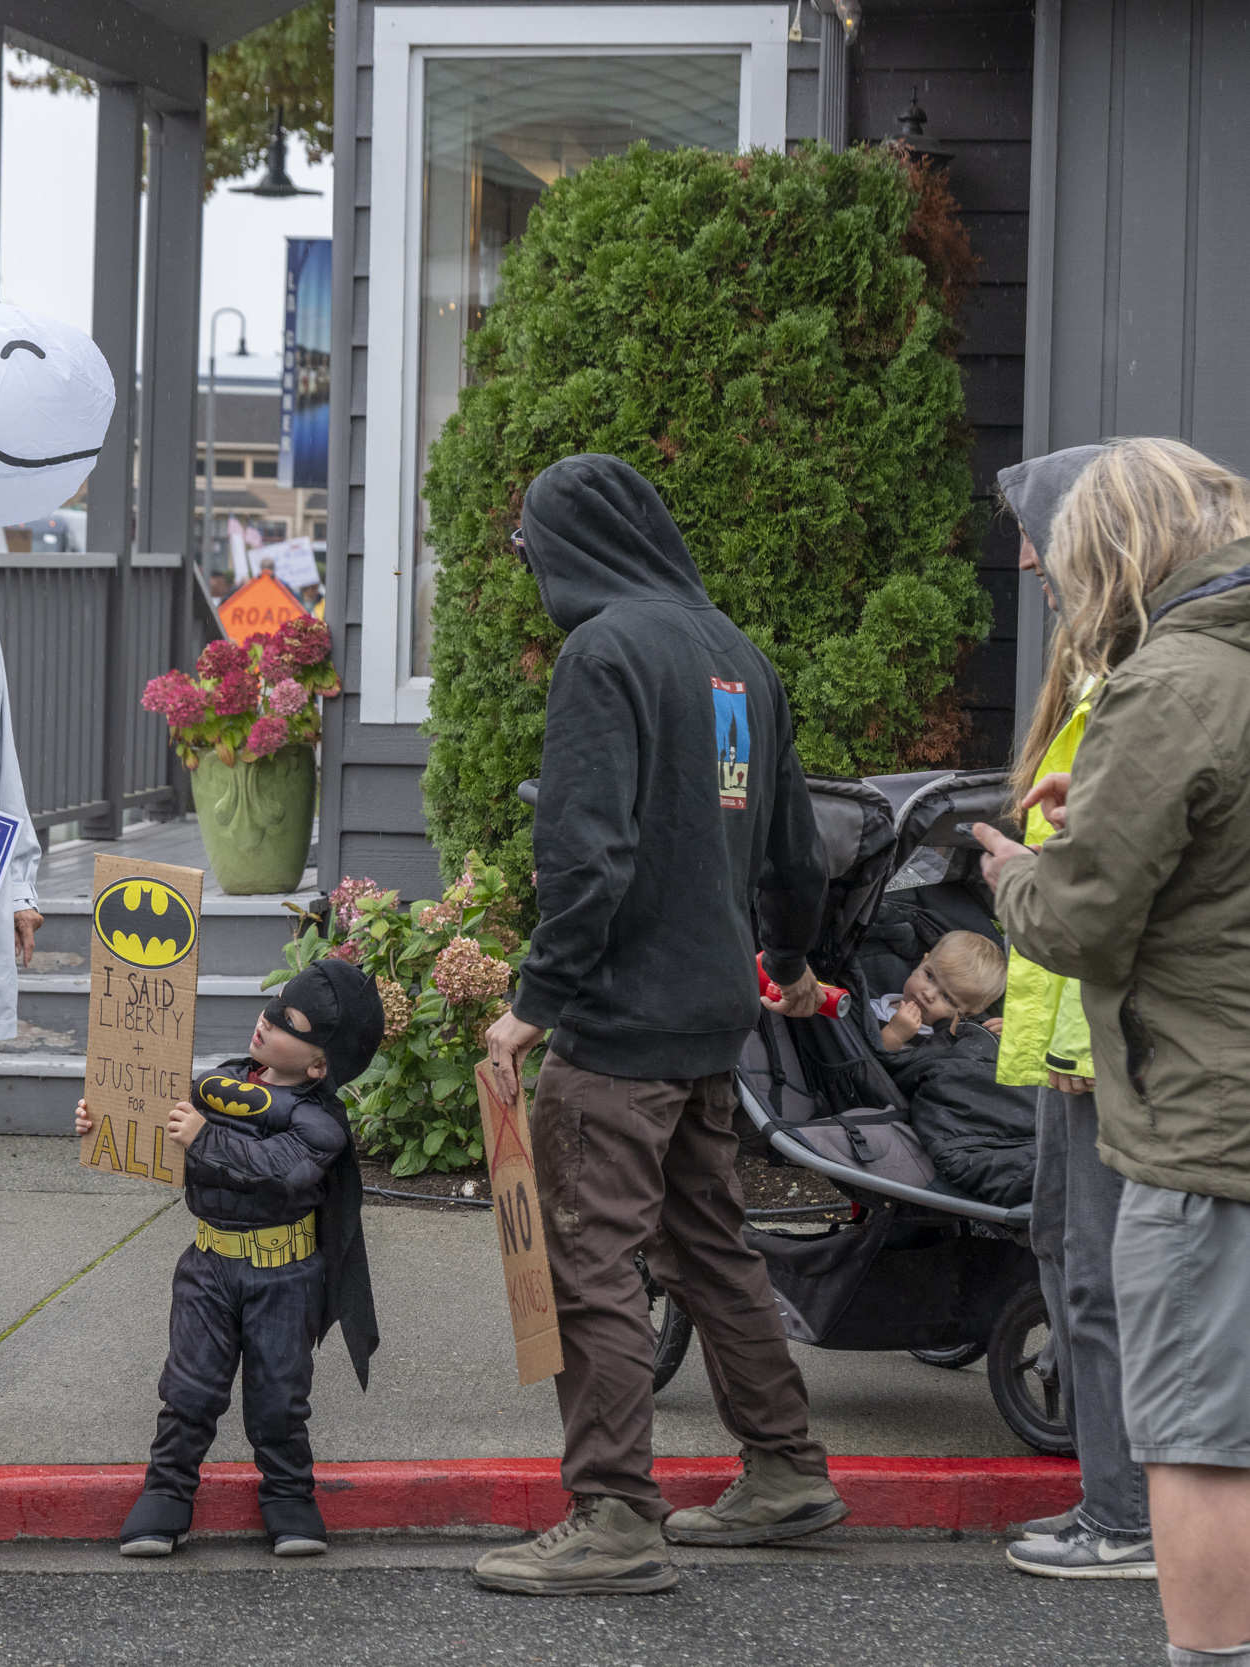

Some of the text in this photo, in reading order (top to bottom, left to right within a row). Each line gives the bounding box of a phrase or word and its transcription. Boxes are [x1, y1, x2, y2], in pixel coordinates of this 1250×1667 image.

[231, 606, 291, 626] ROAD
[103, 966, 175, 1008] I SAID
[100, 999, 184, 1040] LIBERTY
[96, 1057, 180, 1100] JUSTICE
[128, 1096, 145, 1114] FOR
[90, 1115, 173, 1184] ALL
[499, 1181, 532, 1256] NO
[508, 1269, 548, 1324] KINGS
